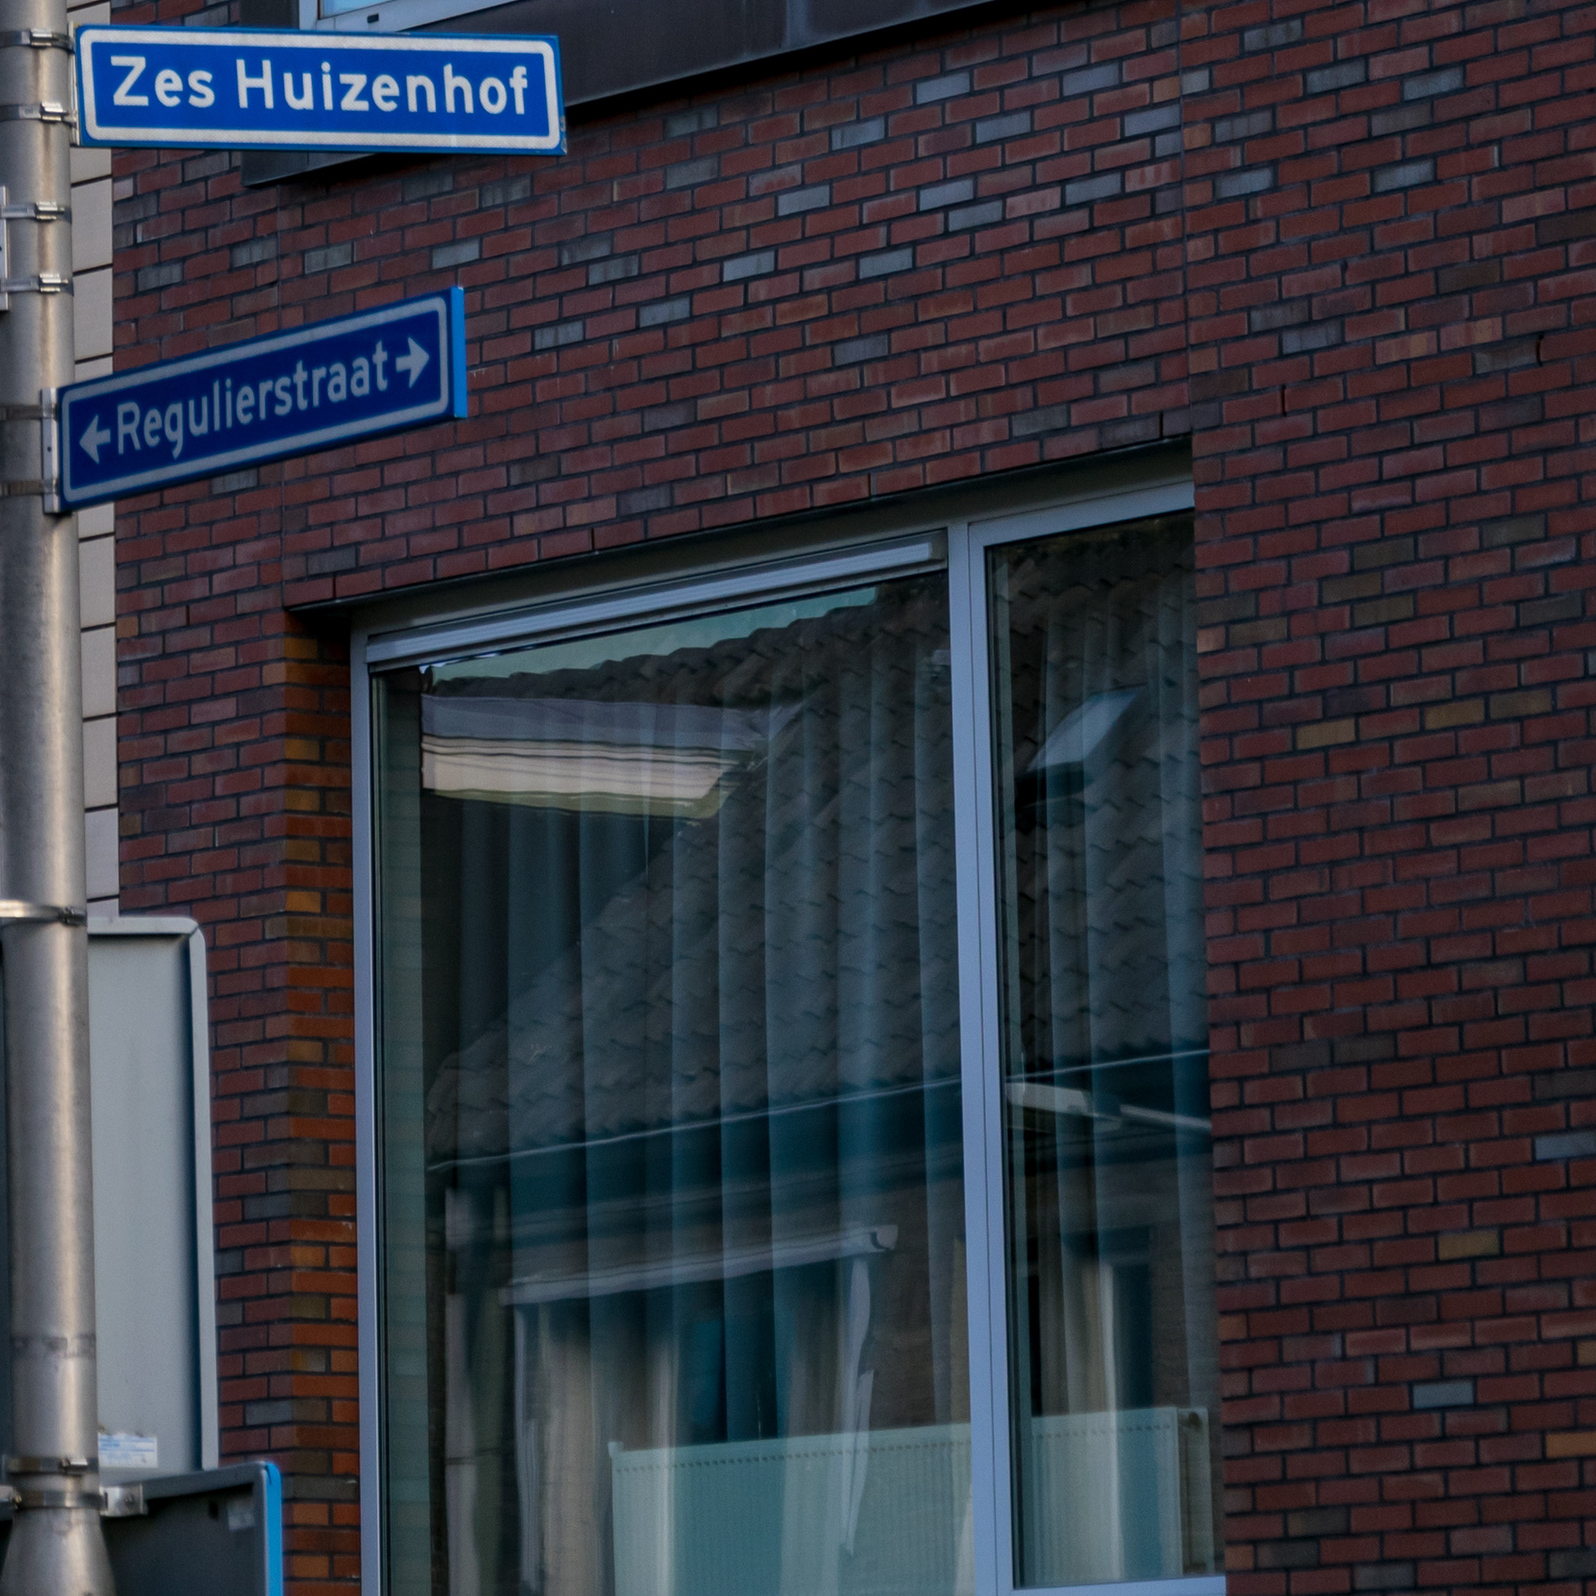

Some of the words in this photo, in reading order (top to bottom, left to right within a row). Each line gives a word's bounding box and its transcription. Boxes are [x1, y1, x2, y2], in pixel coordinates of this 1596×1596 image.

[110, 56, 215, 108] Zes
[236, 59, 528, 114] Huizenhof
[117, 342, 388, 458] Regulierstraat
